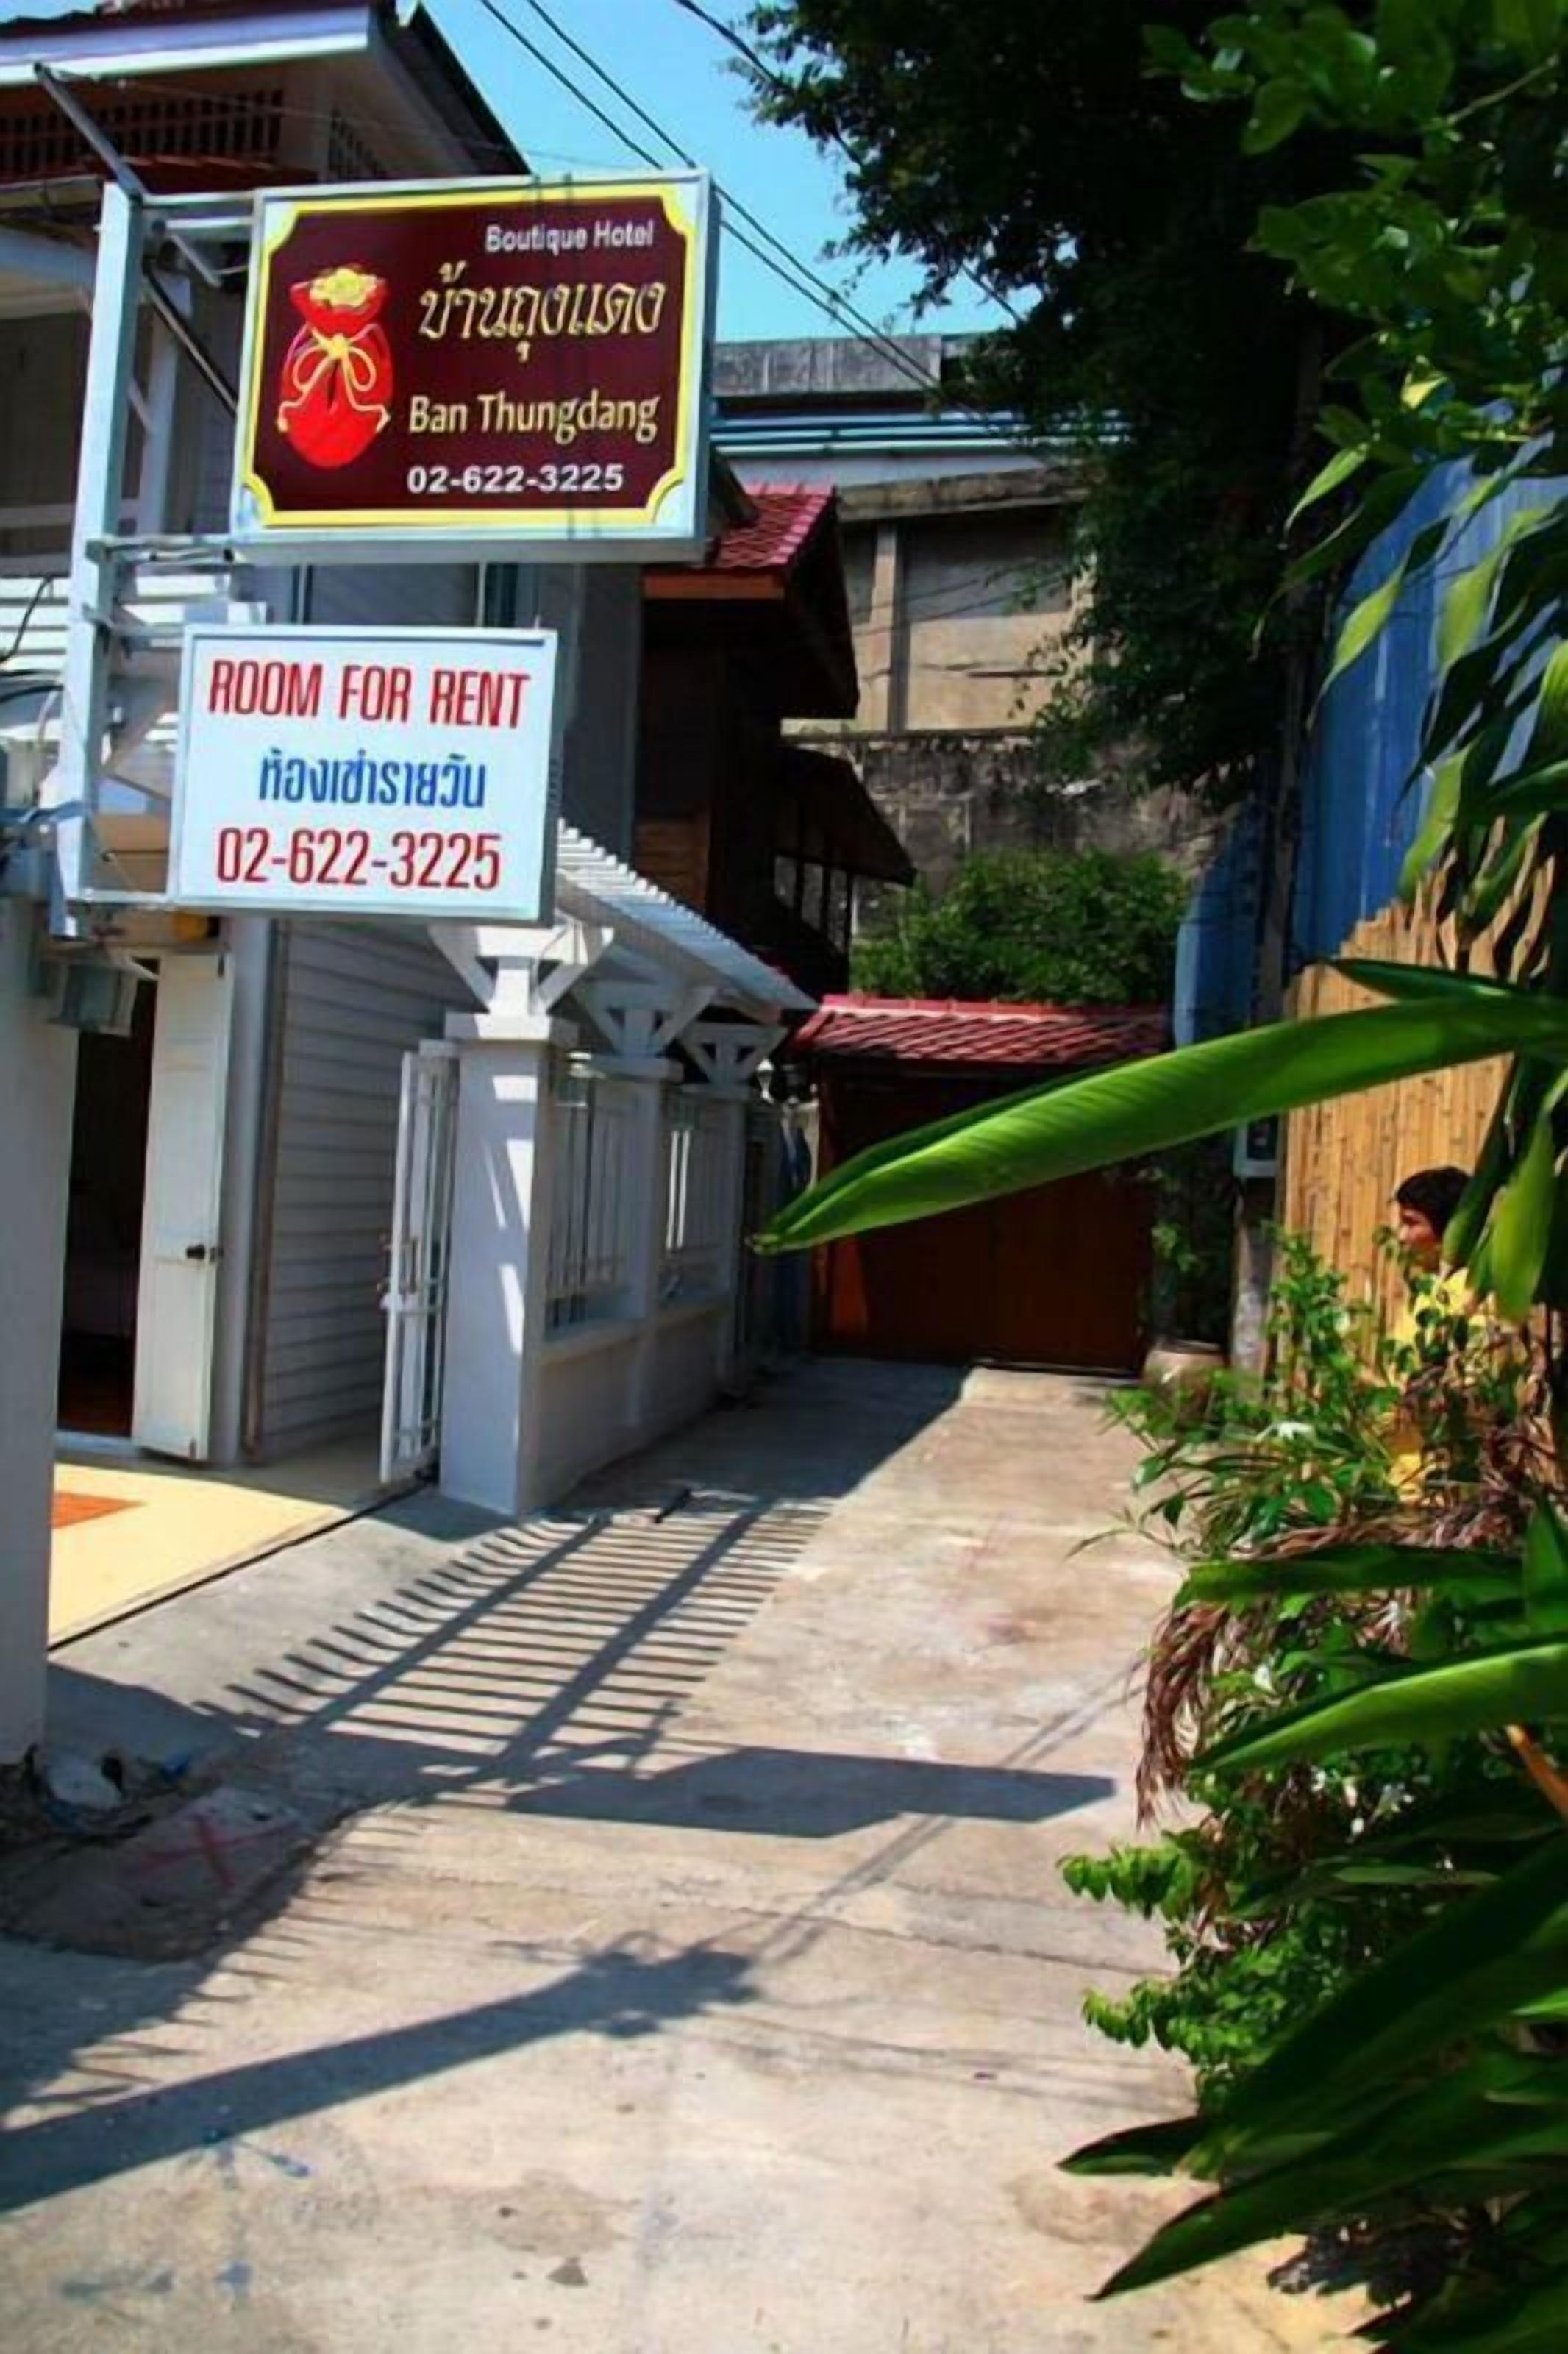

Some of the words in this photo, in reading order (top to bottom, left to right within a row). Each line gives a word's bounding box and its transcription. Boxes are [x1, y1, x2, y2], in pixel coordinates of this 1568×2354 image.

[485, 224, 588, 256] Boutique
[593, 220, 654, 247] Hotel
[419, 260, 666, 362] บ้านถุงแดง
[409, 395, 468, 433] Ban
[477, 388, 660, 444] Thungdang
[407, 464, 624, 494] 02-622-3225
[209, 660, 322, 717] ROOM
[339, 665, 412, 723] FOR
[430, 670, 530, 729] RENT
[259, 747, 486, 808] ห้องเช่ารายวัน
[218, 828, 501, 889] 02-622-3225
